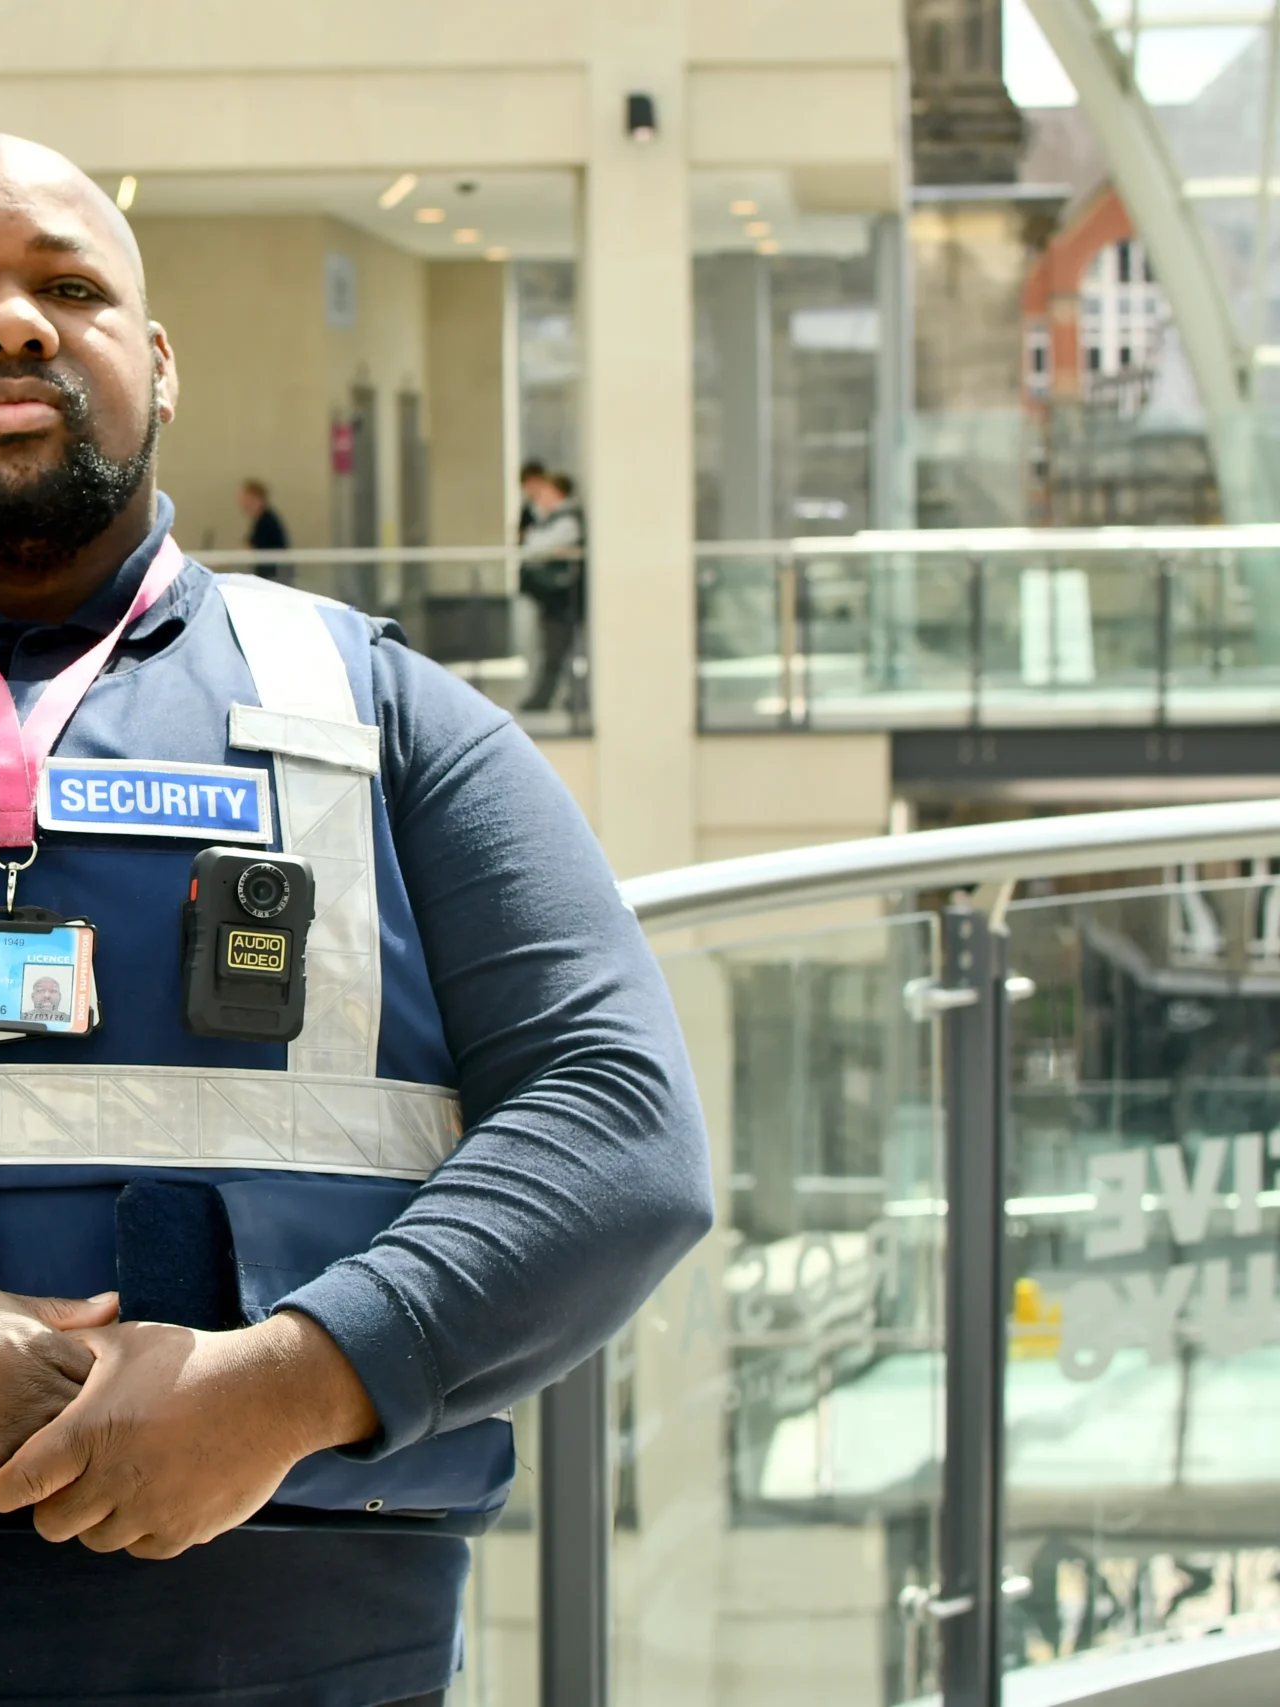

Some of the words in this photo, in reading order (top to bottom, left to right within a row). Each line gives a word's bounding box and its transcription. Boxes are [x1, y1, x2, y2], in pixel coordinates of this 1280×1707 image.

[60, 778, 247, 819] SECURITY
[2, 938, 25, 947] 1949
[233, 934, 281, 952] AUDIO
[26, 954, 71, 965] LICENCE
[80, 935, 89, 991] SUPERVISOR
[232, 950, 280, 968] VIDEO
[77, 992, 86, 1021] DOOR
